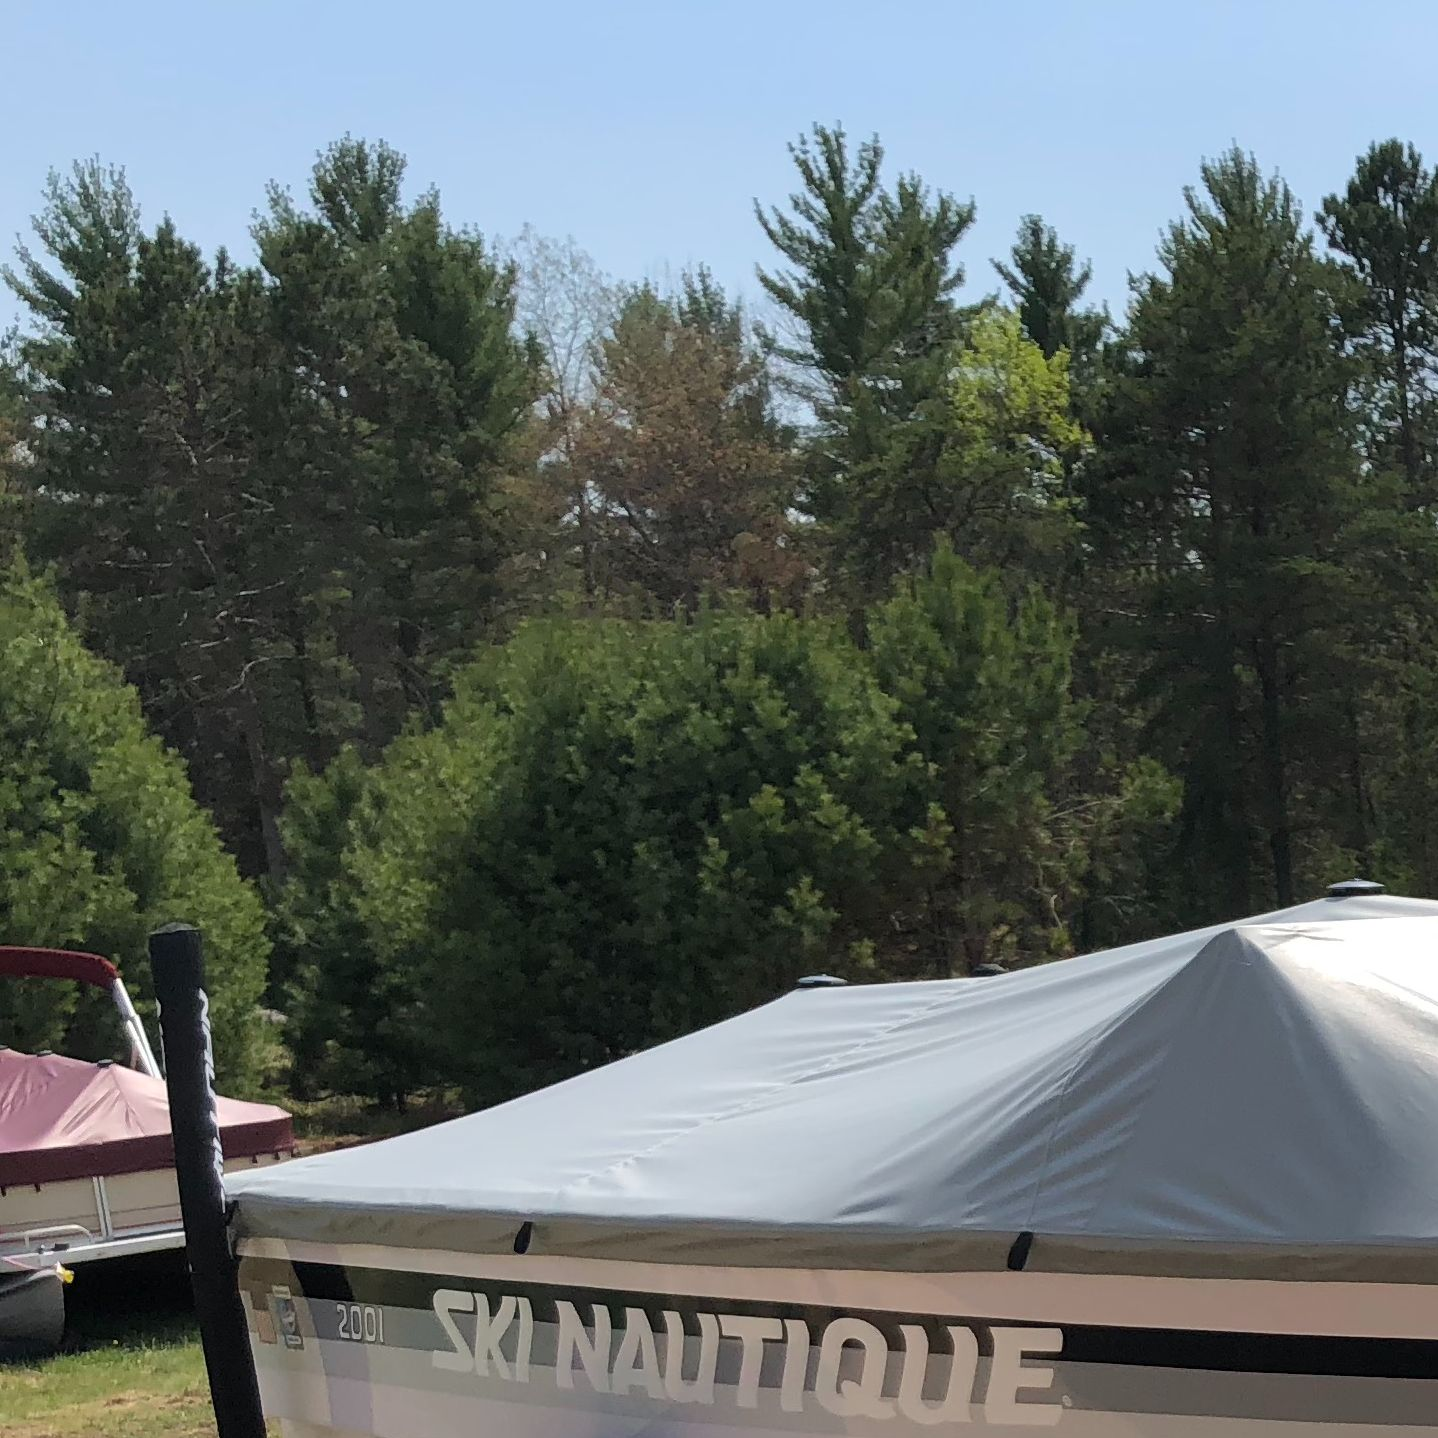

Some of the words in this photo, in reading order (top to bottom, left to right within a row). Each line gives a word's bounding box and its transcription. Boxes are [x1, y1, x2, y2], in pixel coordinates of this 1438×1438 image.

[336, 1303, 384, 1343] 2001
[431, 1288, 534, 1384] SKI
[555, 1299, 1064, 1427] NAUTIQUE
